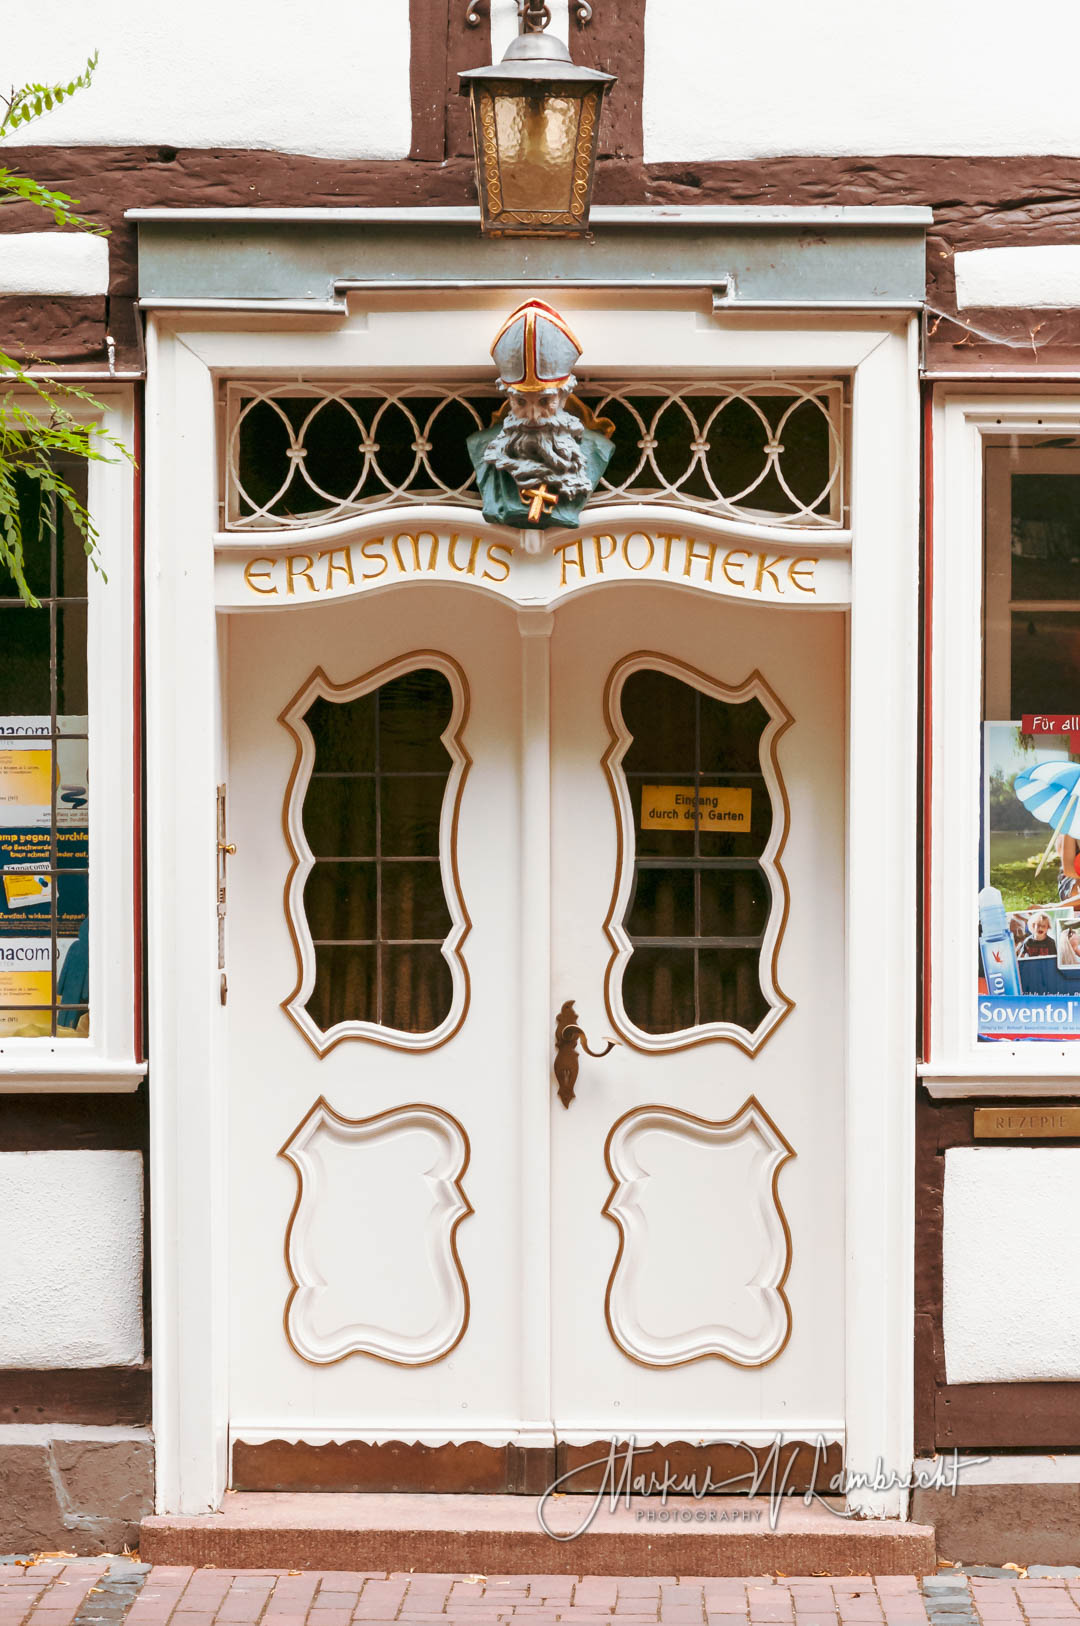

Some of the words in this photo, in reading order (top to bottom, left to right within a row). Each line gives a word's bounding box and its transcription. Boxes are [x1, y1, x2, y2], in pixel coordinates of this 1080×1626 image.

[243, 530, 514, 595] ERASMUS
[553, 530, 819, 595] APOTHEKE
[0, 726, 60, 735] nacom
[1032, 716, 1056, 731] Für
[675, 794, 718, 808] Eingang
[649, 808, 678, 819] durch
[684, 809, 703, 820] den
[708, 810, 744, 821] Garten
[20, 834, 50, 842] gegen
[0, 947, 60, 961] nacom
[980, 1001, 1074, 1023] Soventol
